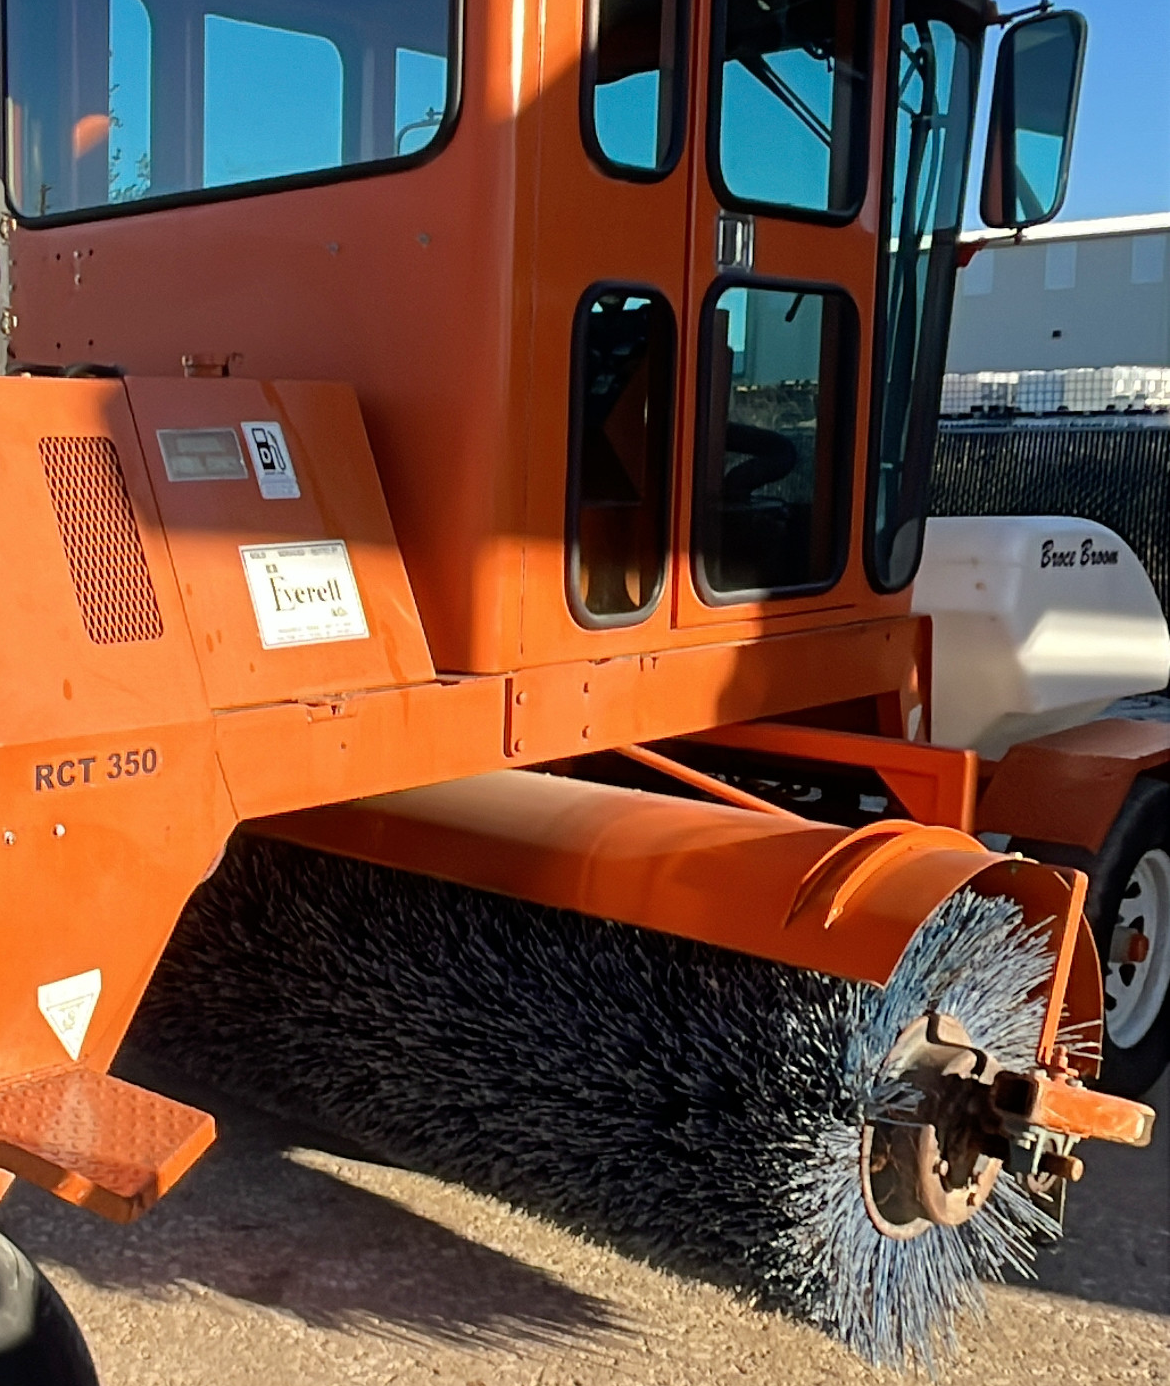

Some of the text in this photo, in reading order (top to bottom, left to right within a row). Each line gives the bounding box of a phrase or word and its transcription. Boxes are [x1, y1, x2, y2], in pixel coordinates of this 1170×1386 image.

[1040, 538, 1119, 569] Broce Broom
[35, 747, 158, 792] RCT 350
